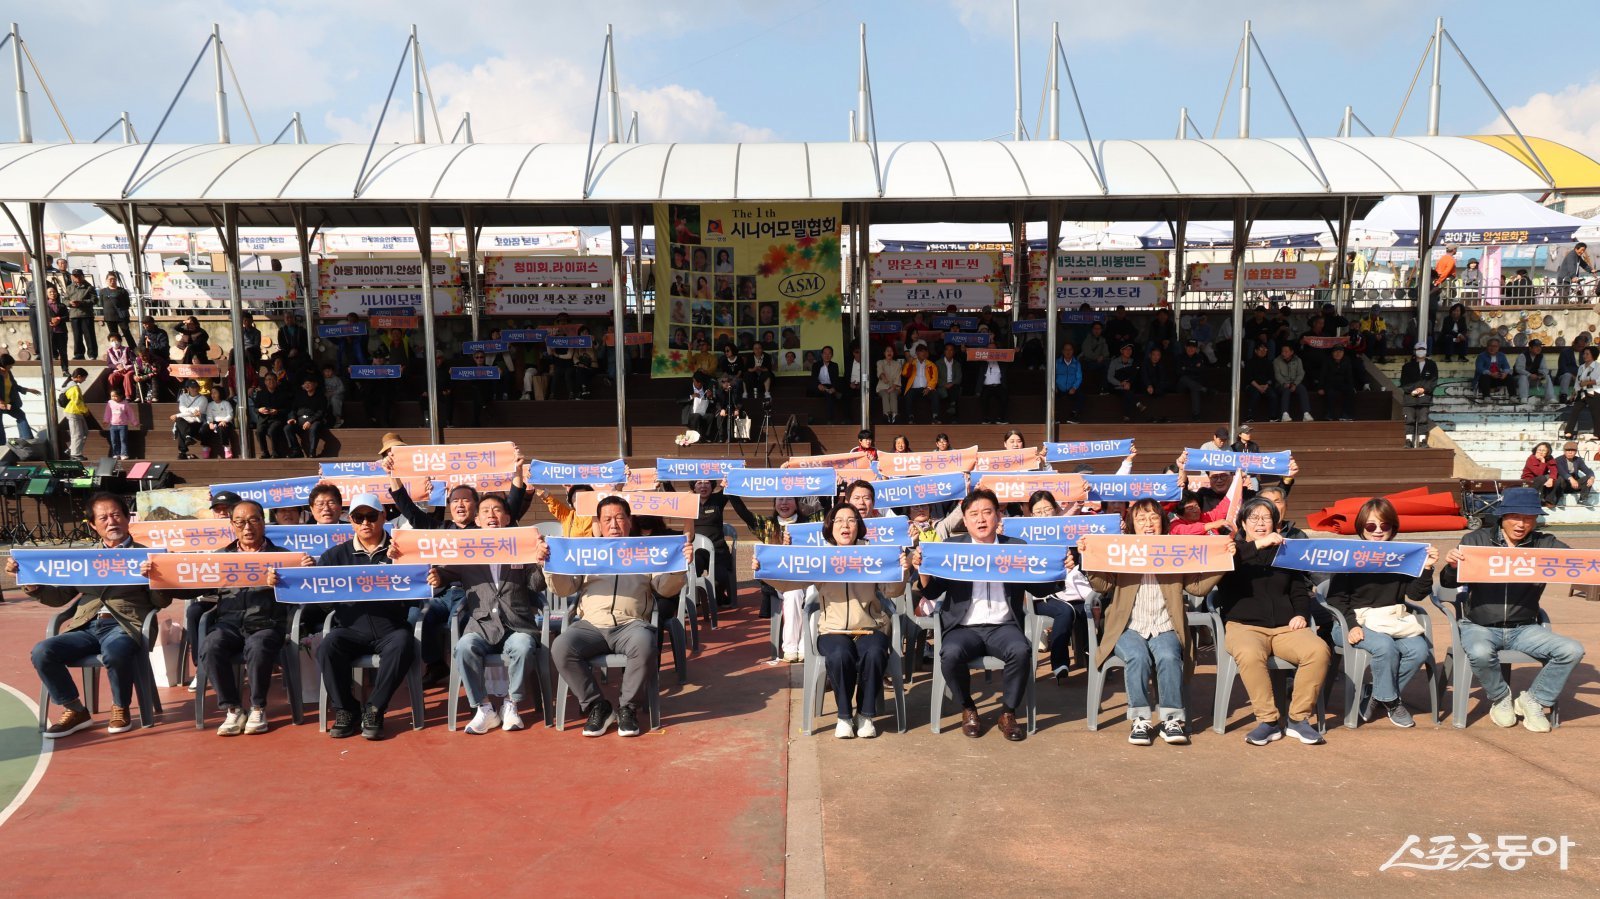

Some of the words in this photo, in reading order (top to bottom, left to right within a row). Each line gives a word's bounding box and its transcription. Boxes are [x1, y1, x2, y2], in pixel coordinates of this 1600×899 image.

[732, 210, 752, 218] The
[731, 217, 836, 238] 시니어모델협회
[1444, 231, 1480, 242] 찾아가는
[1482, 230, 1528, 242] 안성문화장
[942, 258, 979, 270] 레드썬
[785, 277, 819, 294] ASM
[360, 294, 422, 306] 시니어모델
[506, 294, 539, 304] 100인
[583, 294, 606, 305] 공연
[412, 450, 496, 472] 안성공동체
[668, 462, 698, 476] 시민이
[700, 462, 732, 475] 행복한
[893, 453, 962, 472] 안성공동체
[978, 454, 1024, 472] 성공동체
[1201, 452, 1236, 467] 시민이
[1238, 453, 1276, 469] 행복한
[542, 466, 575, 480] 시민이
[578, 465, 614, 478] 행복한
[742, 476, 778, 491] 시민이
[781, 476, 821, 490] 행복한
[878, 486, 912, 502] 시민이
[914, 482, 952, 498] 행복한
[1093, 482, 1127, 496] 시민이
[1130, 482, 1168, 496] 행복한
[269, 486, 310, 502] 행복한
[284, 533, 328, 550] 시민이
[866, 526, 894, 542] 복한
[1020, 526, 1060, 541] 시민이
[418, 536, 518, 559] 안성공동체
[565, 547, 614, 566] 시민이
[617, 546, 669, 566] 행복한
[1107, 543, 1208, 567] 안성공동체
[778, 555, 826, 574] 시민이
[830, 554, 882, 574] 행복한
[941, 554, 990, 572] 시민이
[994, 554, 1048, 574] 행복한
[1300, 548, 1350, 568] 시민이
[1352, 550, 1405, 568] 행복한
[35, 558, 88, 577] 시민이
[92, 558, 147, 578] 행복한
[300, 575, 352, 594] 시민이
[356, 574, 412, 592] 행복한
